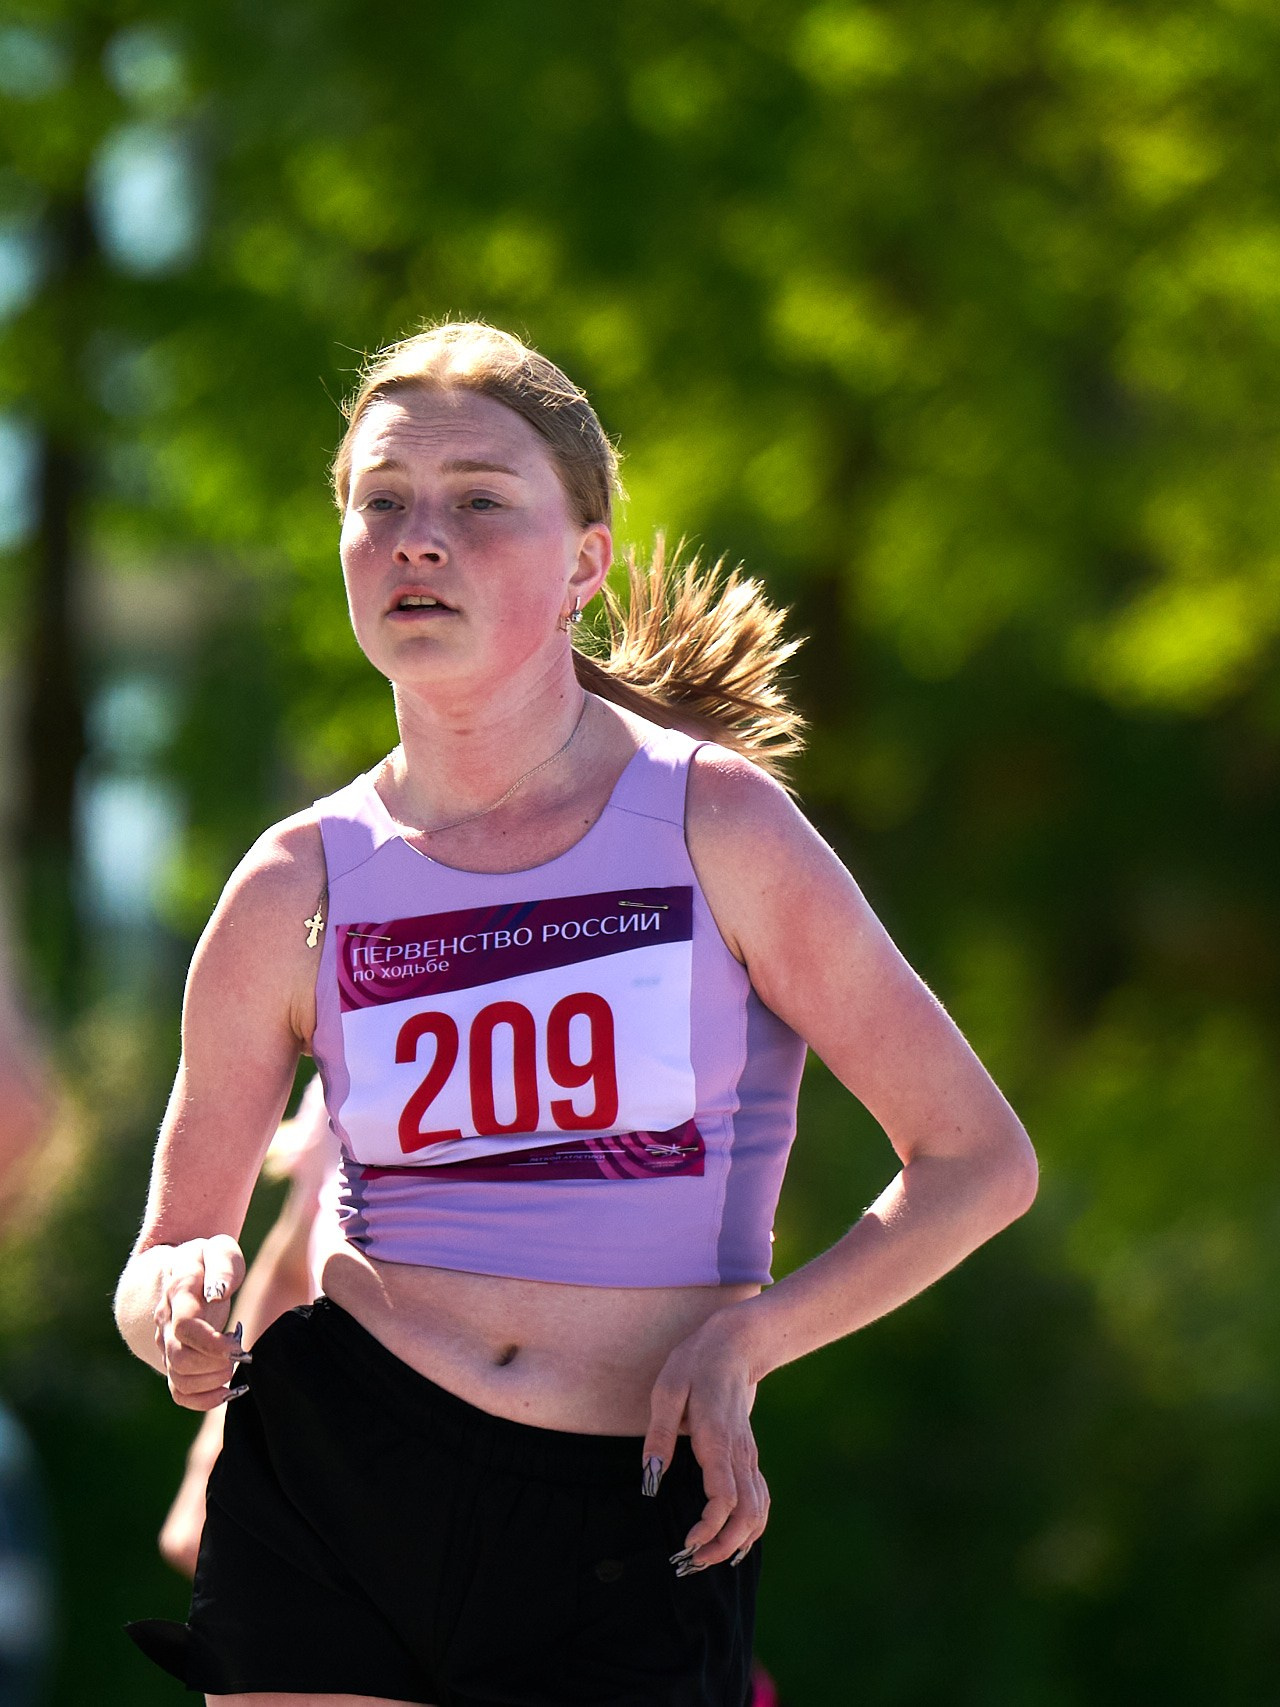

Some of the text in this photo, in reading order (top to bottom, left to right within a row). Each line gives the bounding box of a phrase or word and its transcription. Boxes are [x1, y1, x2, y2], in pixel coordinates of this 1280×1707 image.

[352, 912, 661, 967] ПЕРВЕНСТВО РОССИИ
[352, 958, 450, 983] по ходьбе
[394, 991, 619, 1154] 209
